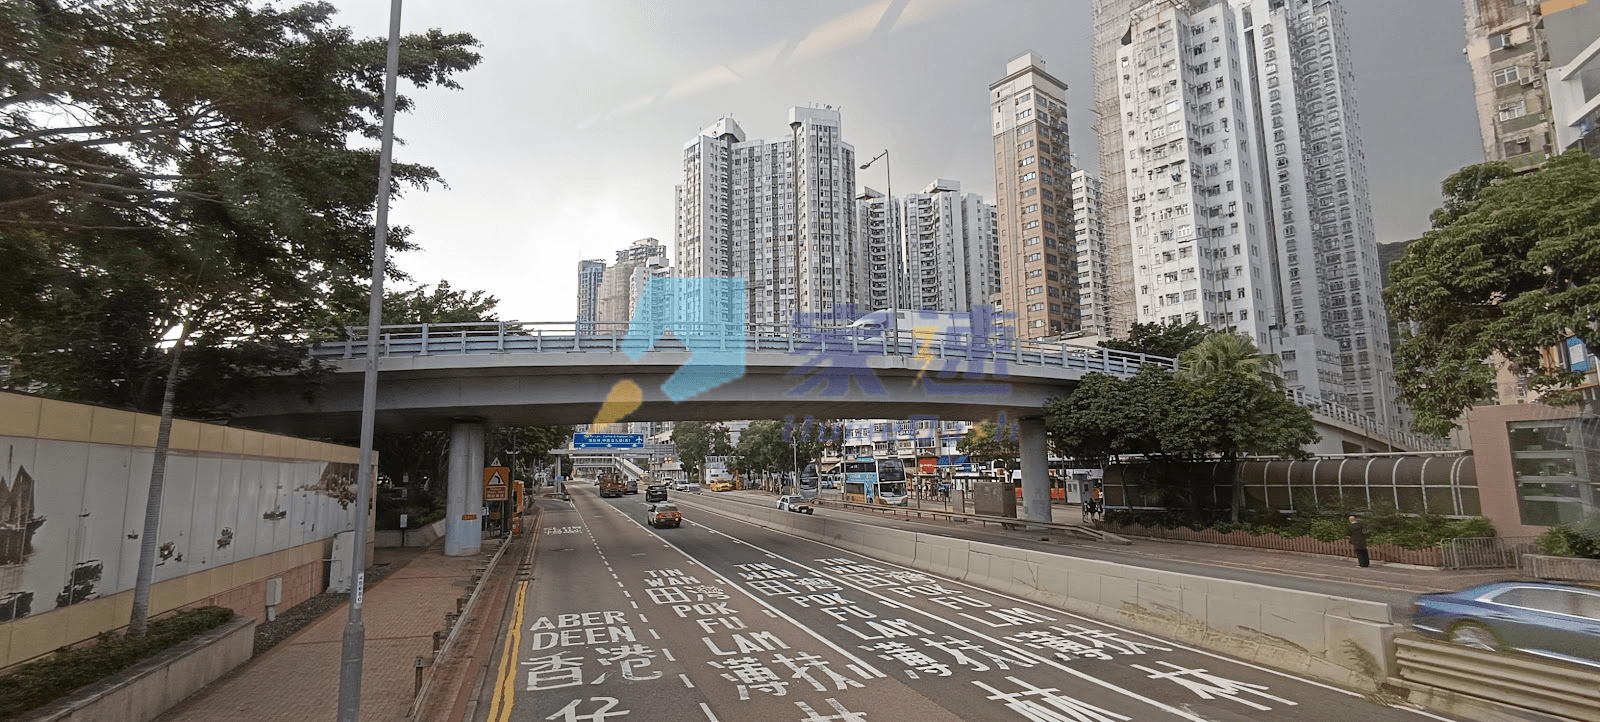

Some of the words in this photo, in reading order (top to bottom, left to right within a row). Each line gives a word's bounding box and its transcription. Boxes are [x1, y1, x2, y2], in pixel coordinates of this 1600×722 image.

[644, 568, 685, 577] TIN
[733, 562, 777, 572] TIN
[738, 568, 798, 580] WAN
[644, 576, 701, 588] WAN
[887, 583, 963, 598] POK
[672, 601, 739, 618] POK
[787, 593, 856, 608] POK
[928, 595, 992, 610] FU
[529, 611, 629, 631] ABER
[820, 605, 877, 622] FU
[957, 607, 1057, 628] LAM
[696, 616, 748, 634] FU
[836, 618, 936, 640] LAM
[532, 625, 637, 650] DEEN
[702, 631, 791, 656] LAM
[857, 635, 1034, 680] 薄扶
[521, 644, 663, 691] 香港
[707, 651, 866, 701] 薄扶
[1130, 660, 1299, 711] 林
[971, 676, 1133, 722] 林
